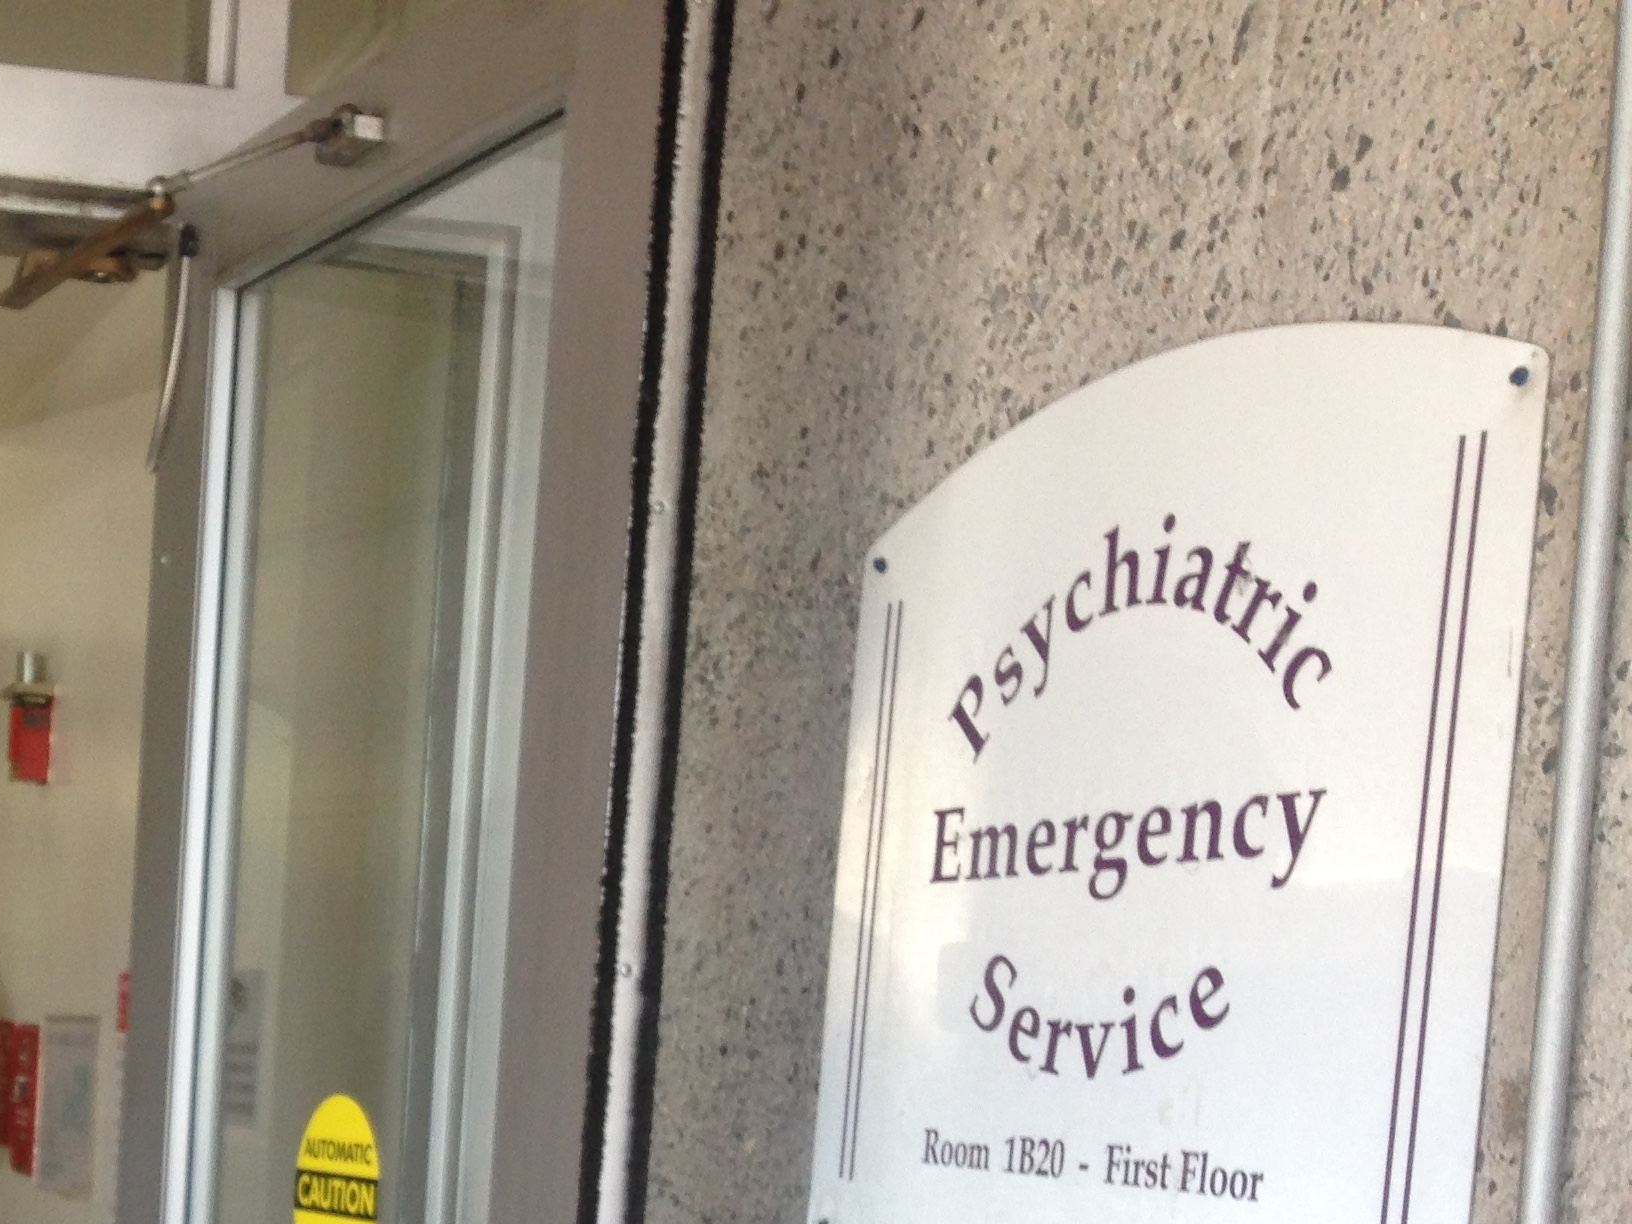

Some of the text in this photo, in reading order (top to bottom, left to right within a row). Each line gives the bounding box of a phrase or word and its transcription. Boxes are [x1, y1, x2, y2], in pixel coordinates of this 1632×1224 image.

[948, 513, 1332, 764] Psychiatric
[930, 789, 1326, 901] Emergency
[969, 954, 1229, 1080] Service
[297, 1174, 375, 1216] CAUTION
[305, 1138, 372, 1165] AUTOMATIC
[921, 1128, 990, 1171] Room
[1004, 1136, 1065, 1179] 1B20
[1104, 1143, 1171, 1190] First
[1177, 1150, 1264, 1201] Floor
